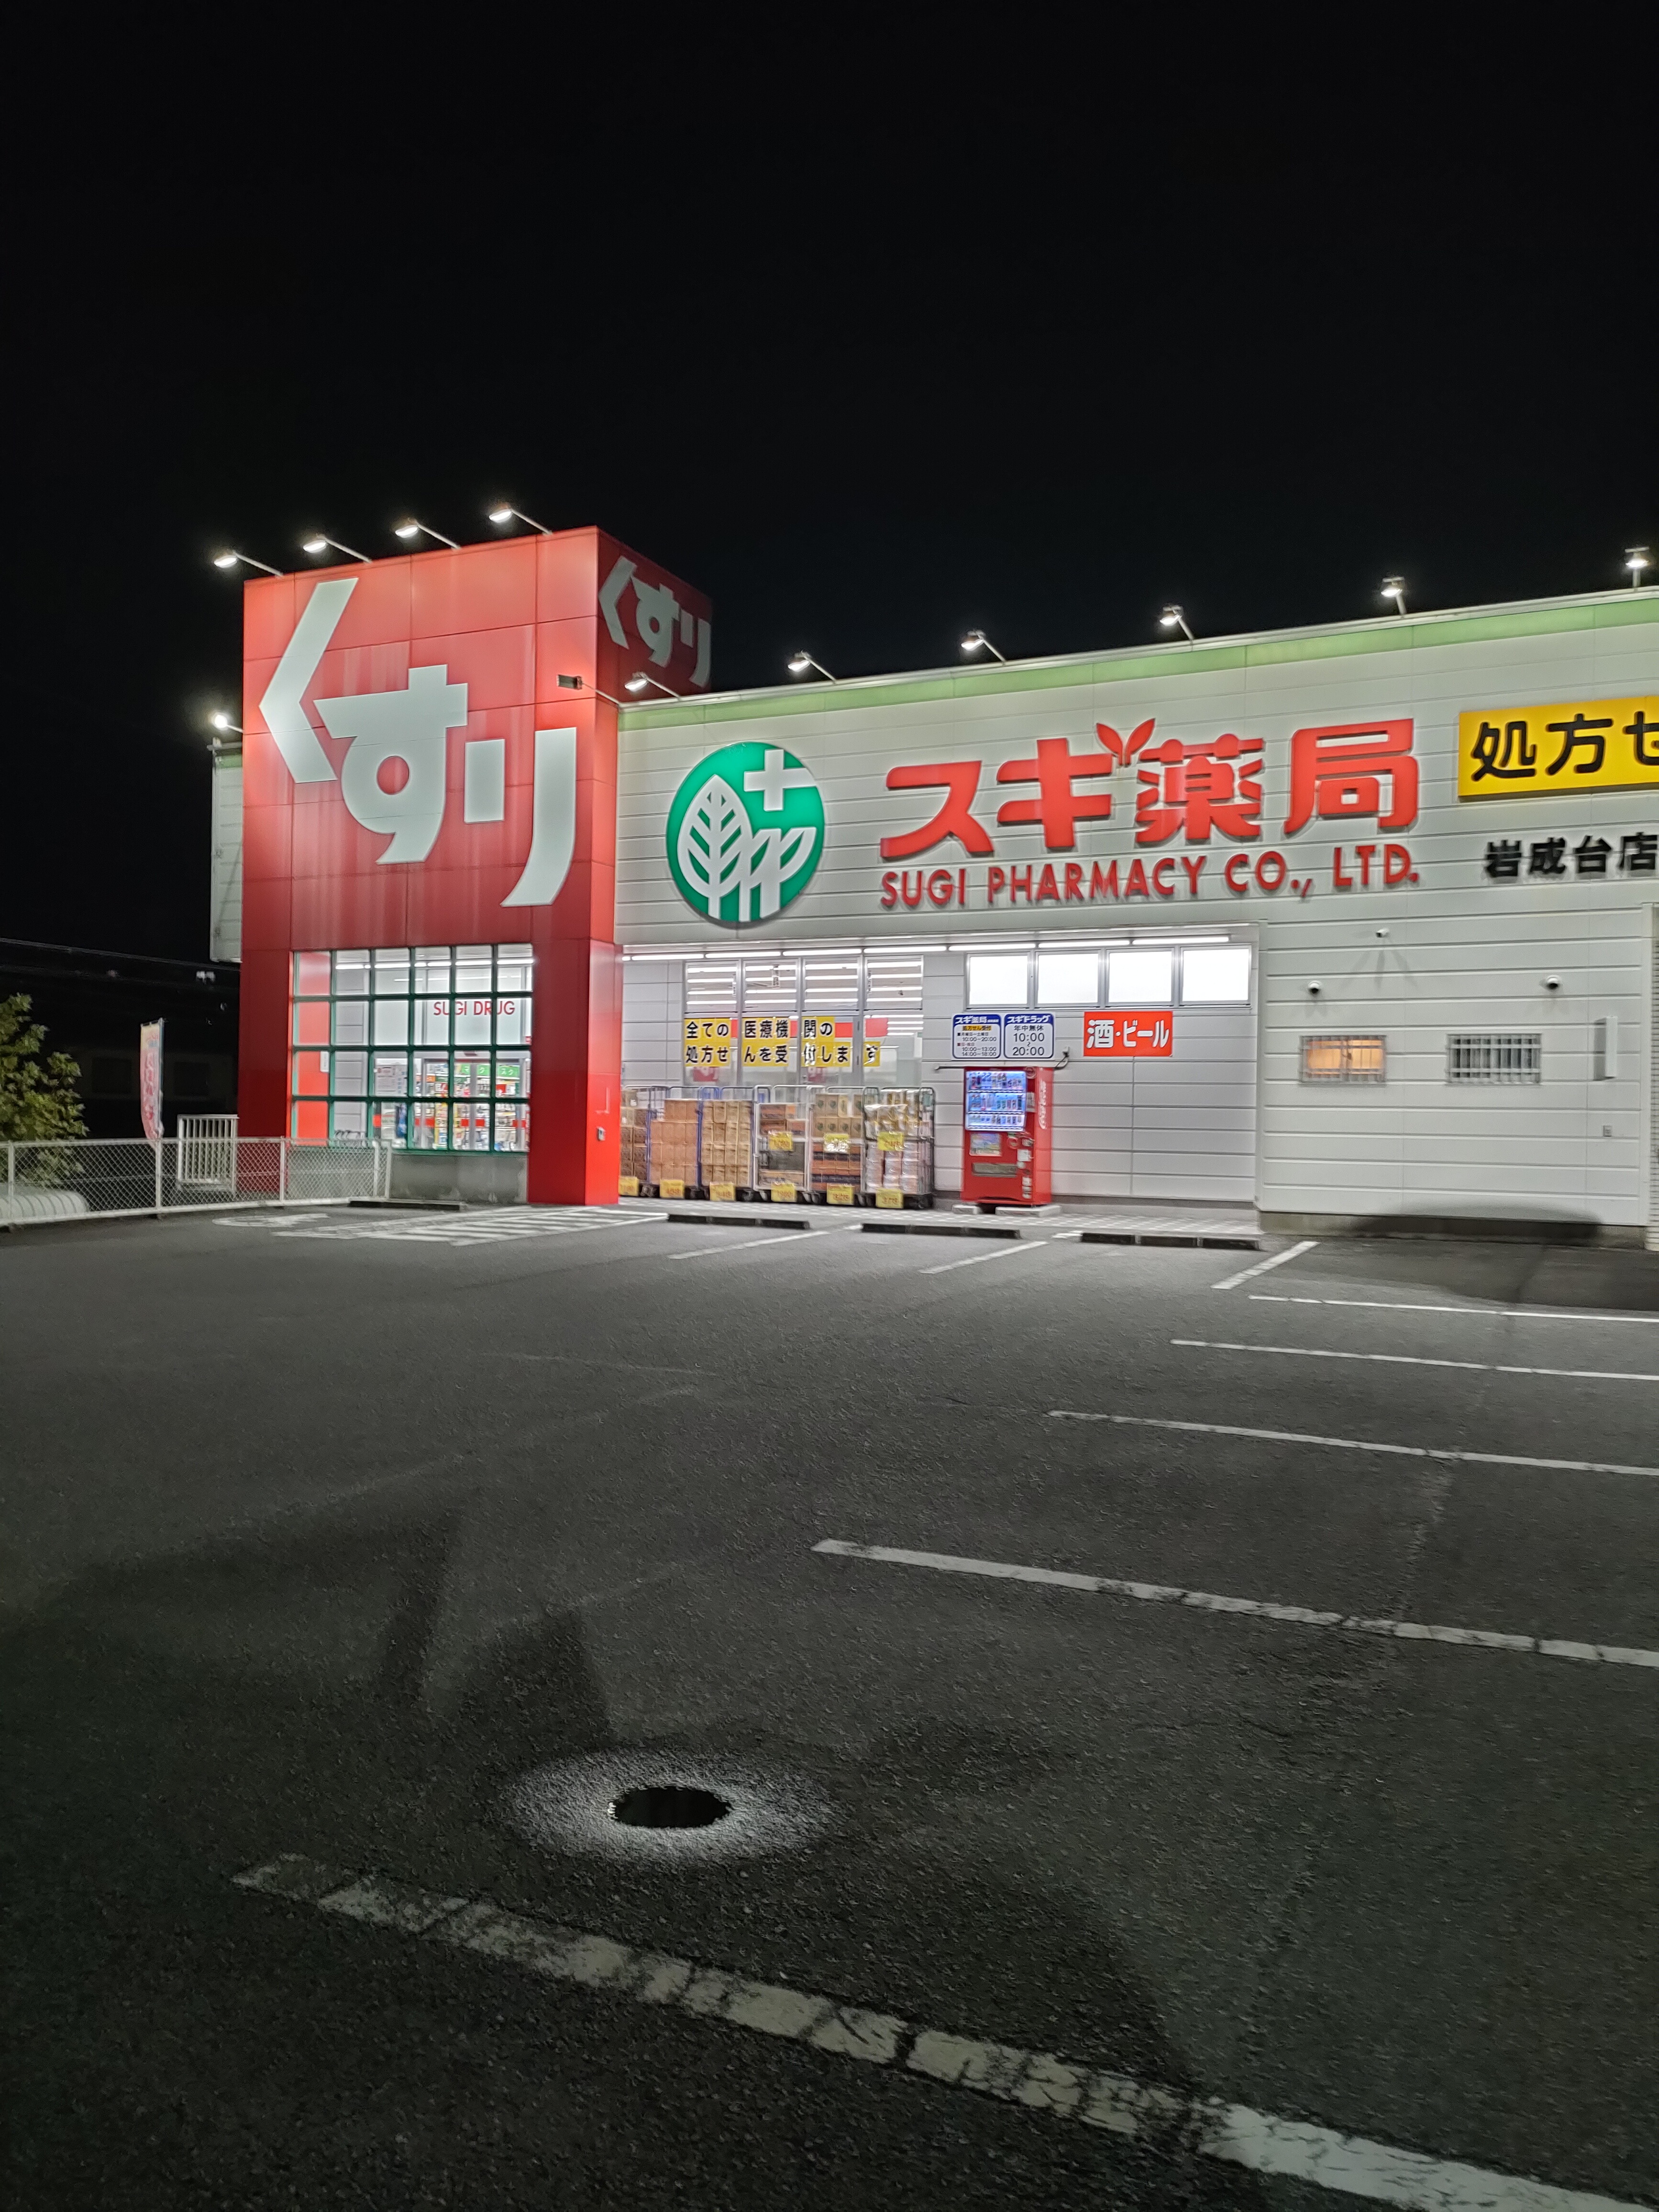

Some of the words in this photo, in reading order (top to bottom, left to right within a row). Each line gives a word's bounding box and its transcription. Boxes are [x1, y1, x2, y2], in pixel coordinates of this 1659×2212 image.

[598, 555, 712, 688] くすり
[259, 577, 577, 907] くすり
[880, 718, 1420, 860] スギ薬局
[1485, 832, 1659, 877] 岩成台店
[881, 869, 966, 907] SUGI
[987, 855, 1207, 904] PHARMACY
[1225, 851, 1312, 897] CO.,
[1334, 844, 1419, 888] LTD.
[433, 1001, 467, 1015] SUGI
[474, 1001, 515, 1015] DRUG
[955, 1016, 987, 1024] スギ薬局
[1007, 1015, 1051, 1023] スギドラッグ
[1013, 1033, 1045, 1042] 10:00
[1086, 1019, 1170, 1049] 酒・ビール
[1012, 1047, 1045, 1056] 20:00
